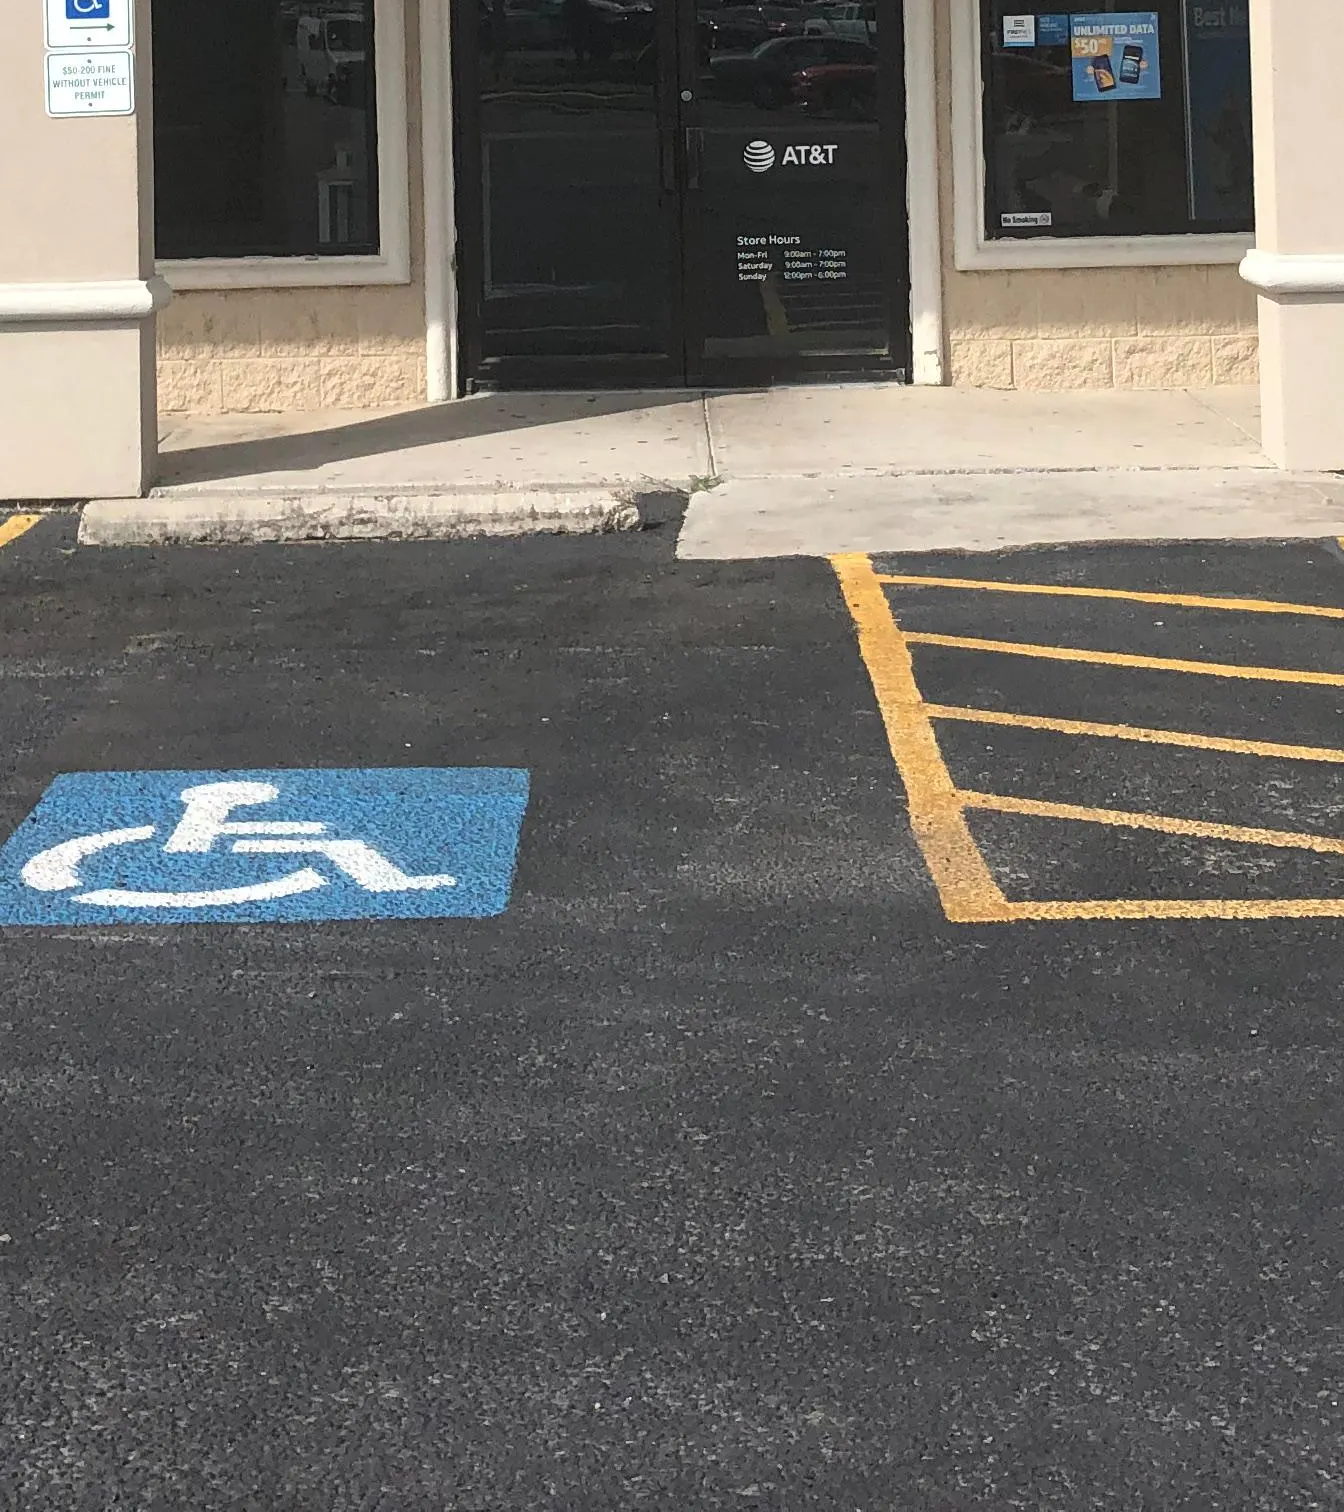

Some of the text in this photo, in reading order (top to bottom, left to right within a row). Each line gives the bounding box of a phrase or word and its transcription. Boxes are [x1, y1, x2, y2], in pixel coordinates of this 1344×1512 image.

[1073, 24, 1128, 36] UNLIMITED
[1129, 23, 1155, 34] DATA
[62, 64, 116, 75] $50-200 FINE
[53, 77, 127, 88] WITHOUT VEHICLE
[74, 90, 105, 100] PERMIT
[781, 144, 838, 165] AT&T
[737, 235, 801, 245] Store Hours
[737, 251, 768, 259] Mon-Fri
[738, 261, 773, 271] Saturday
[738, 273, 767, 282] Sunday
